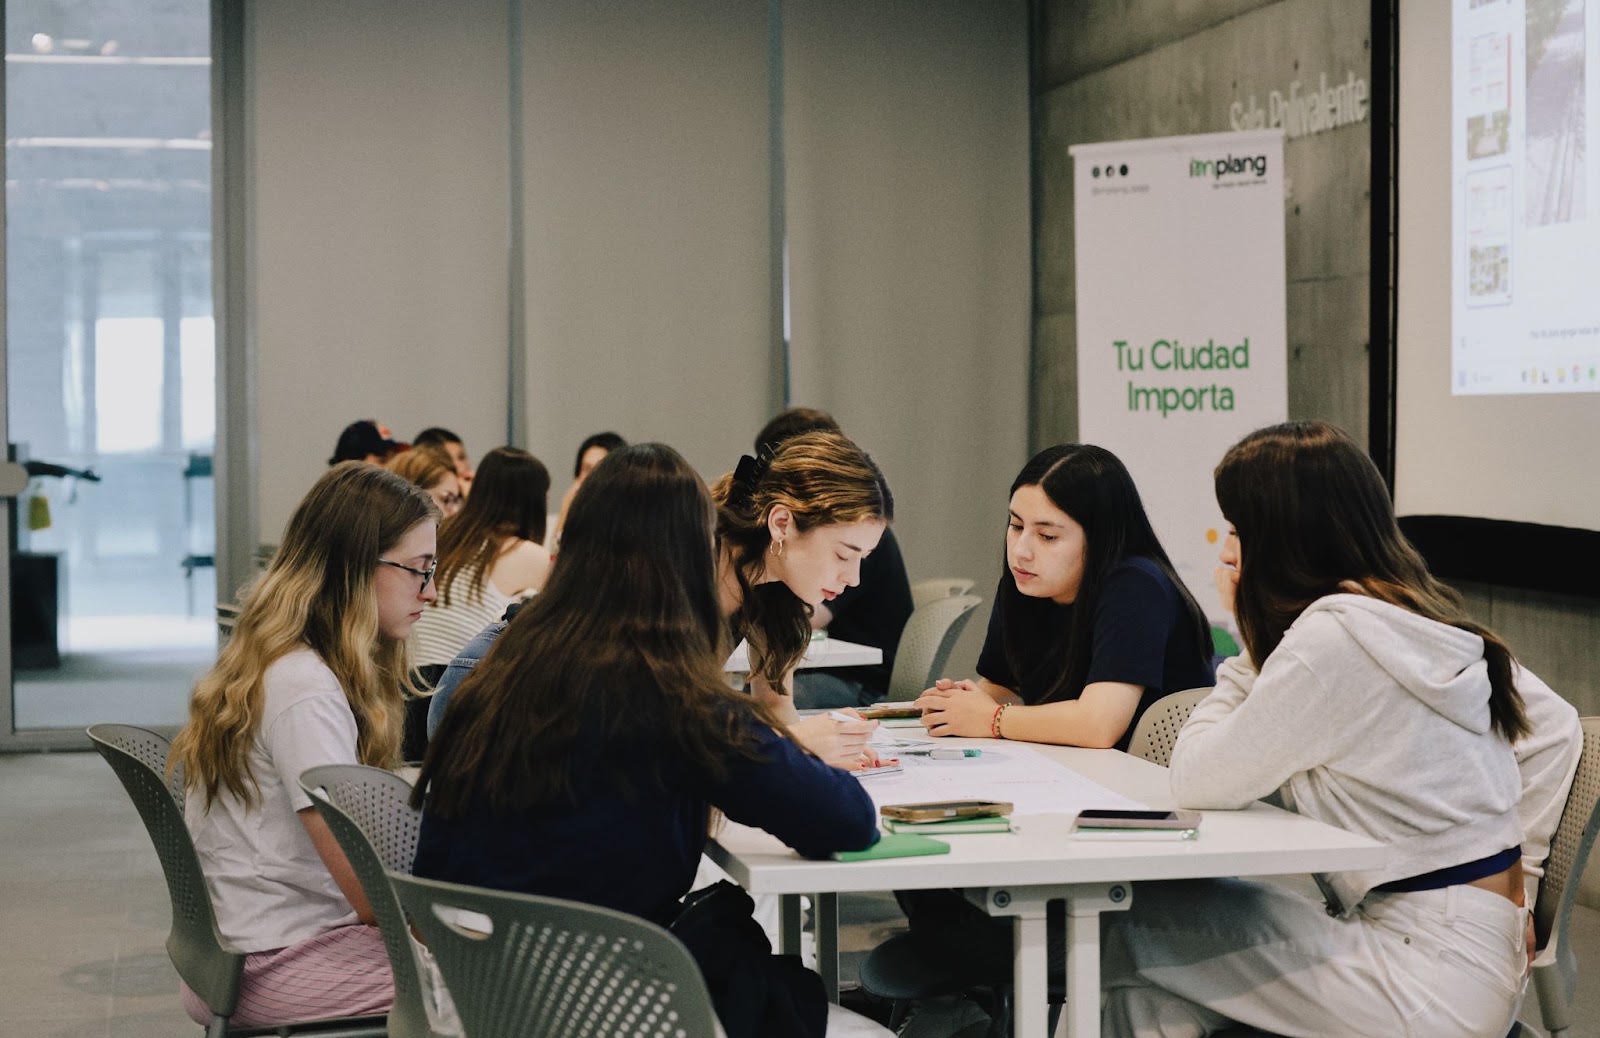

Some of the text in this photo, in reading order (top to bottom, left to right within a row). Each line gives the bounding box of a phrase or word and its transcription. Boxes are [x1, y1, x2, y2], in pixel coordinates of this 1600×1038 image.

[1113, 337, 1250, 371] Tu Ciudad
[1127, 381, 1235, 418] Importa
